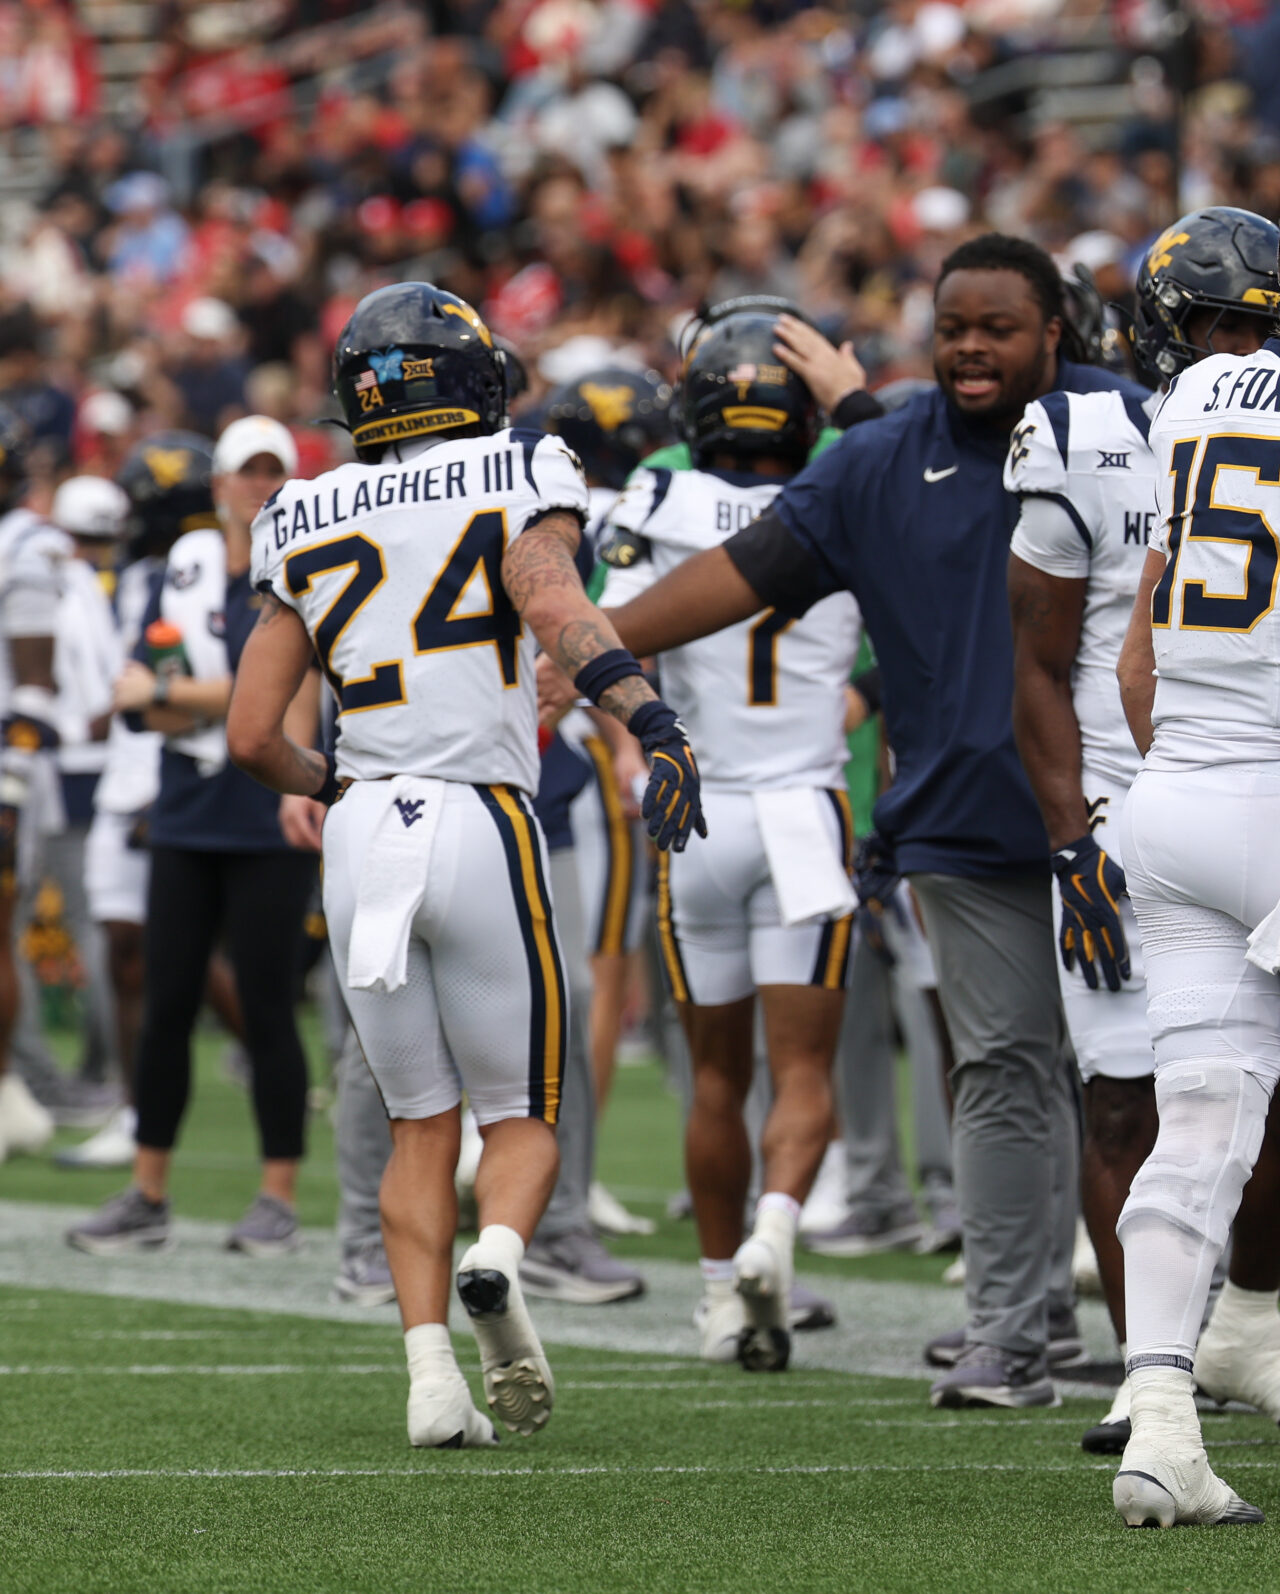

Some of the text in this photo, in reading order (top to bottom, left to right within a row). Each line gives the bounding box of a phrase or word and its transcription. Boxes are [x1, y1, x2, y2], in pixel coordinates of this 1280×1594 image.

[357, 386, 384, 413] 24
[272, 450, 514, 549] GALLAGHER III
[285, 507, 524, 717] 24
